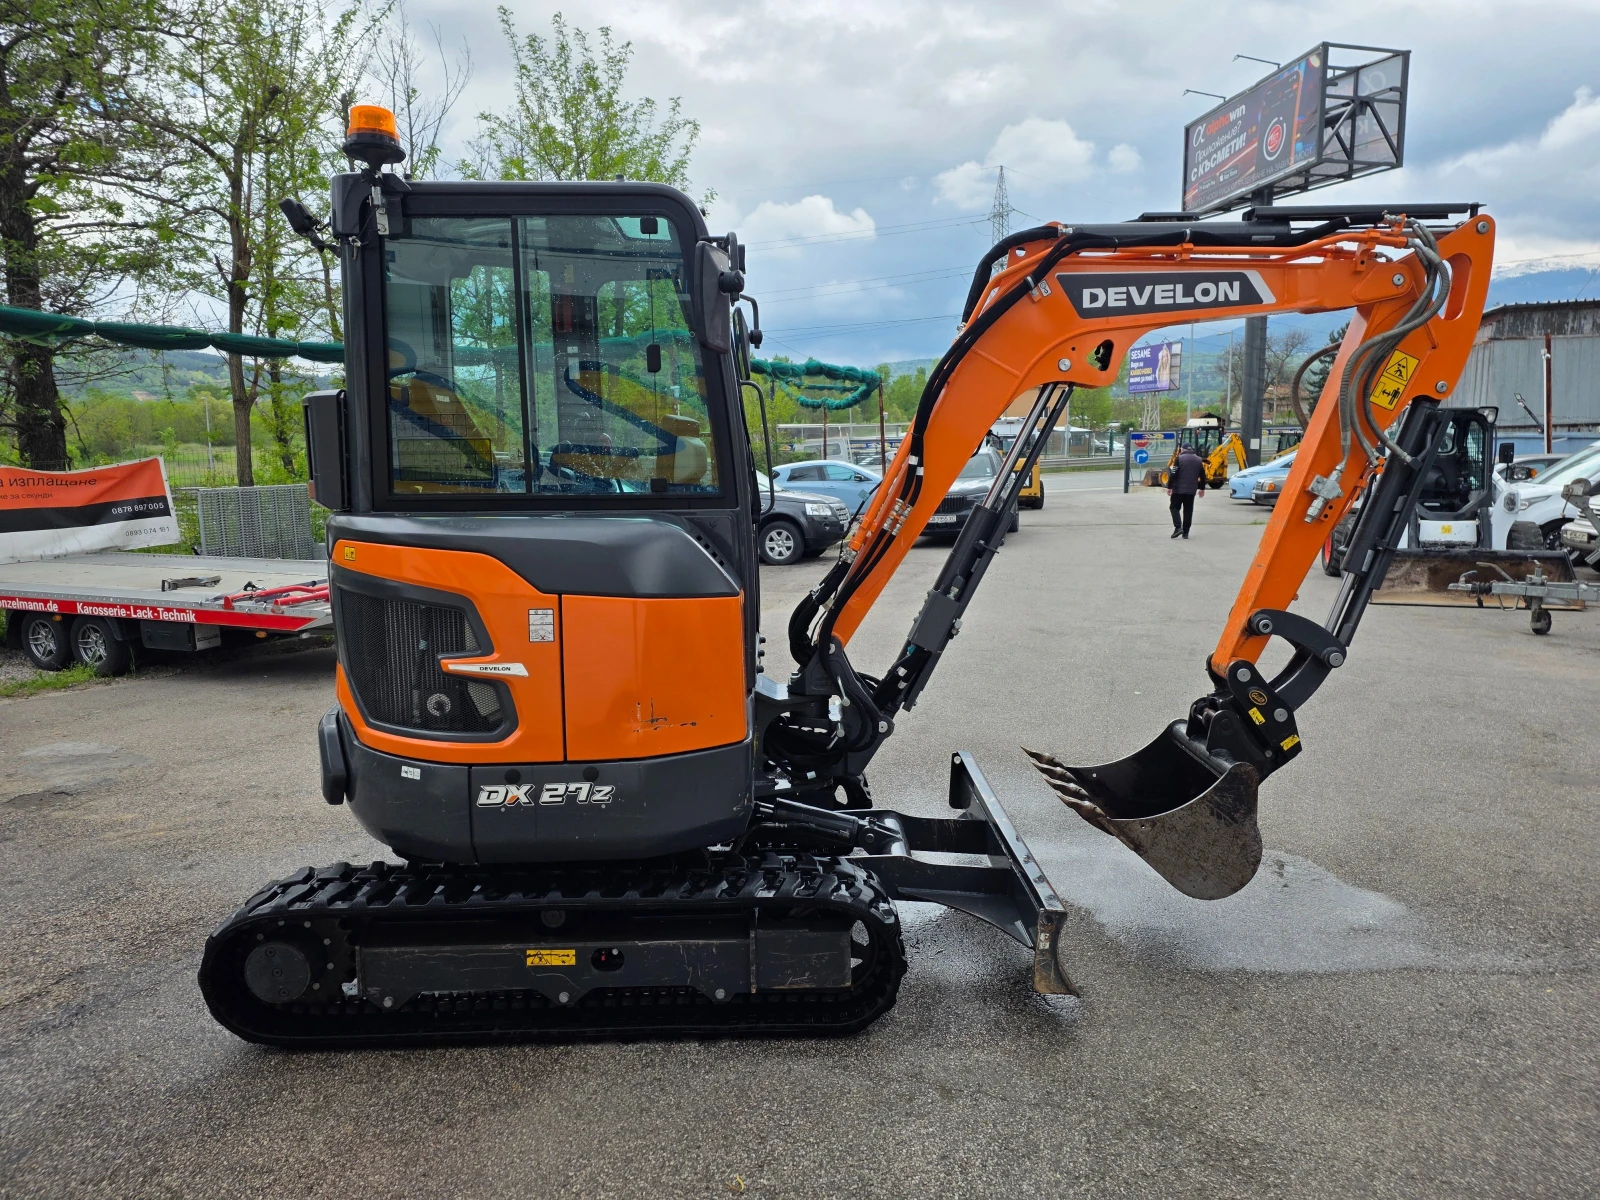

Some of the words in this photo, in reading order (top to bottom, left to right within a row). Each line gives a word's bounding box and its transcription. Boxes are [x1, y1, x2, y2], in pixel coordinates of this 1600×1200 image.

[1206, 104, 1246, 135] alphawin
[1082, 281, 1240, 308] DEVELON
[1131, 349, 1151, 359] SESAME
[9, 477, 98, 488] изплащане
[22, 492, 53, 500] секунди
[111, 505, 133, 514] 0878
[476, 783, 536, 808] DX
